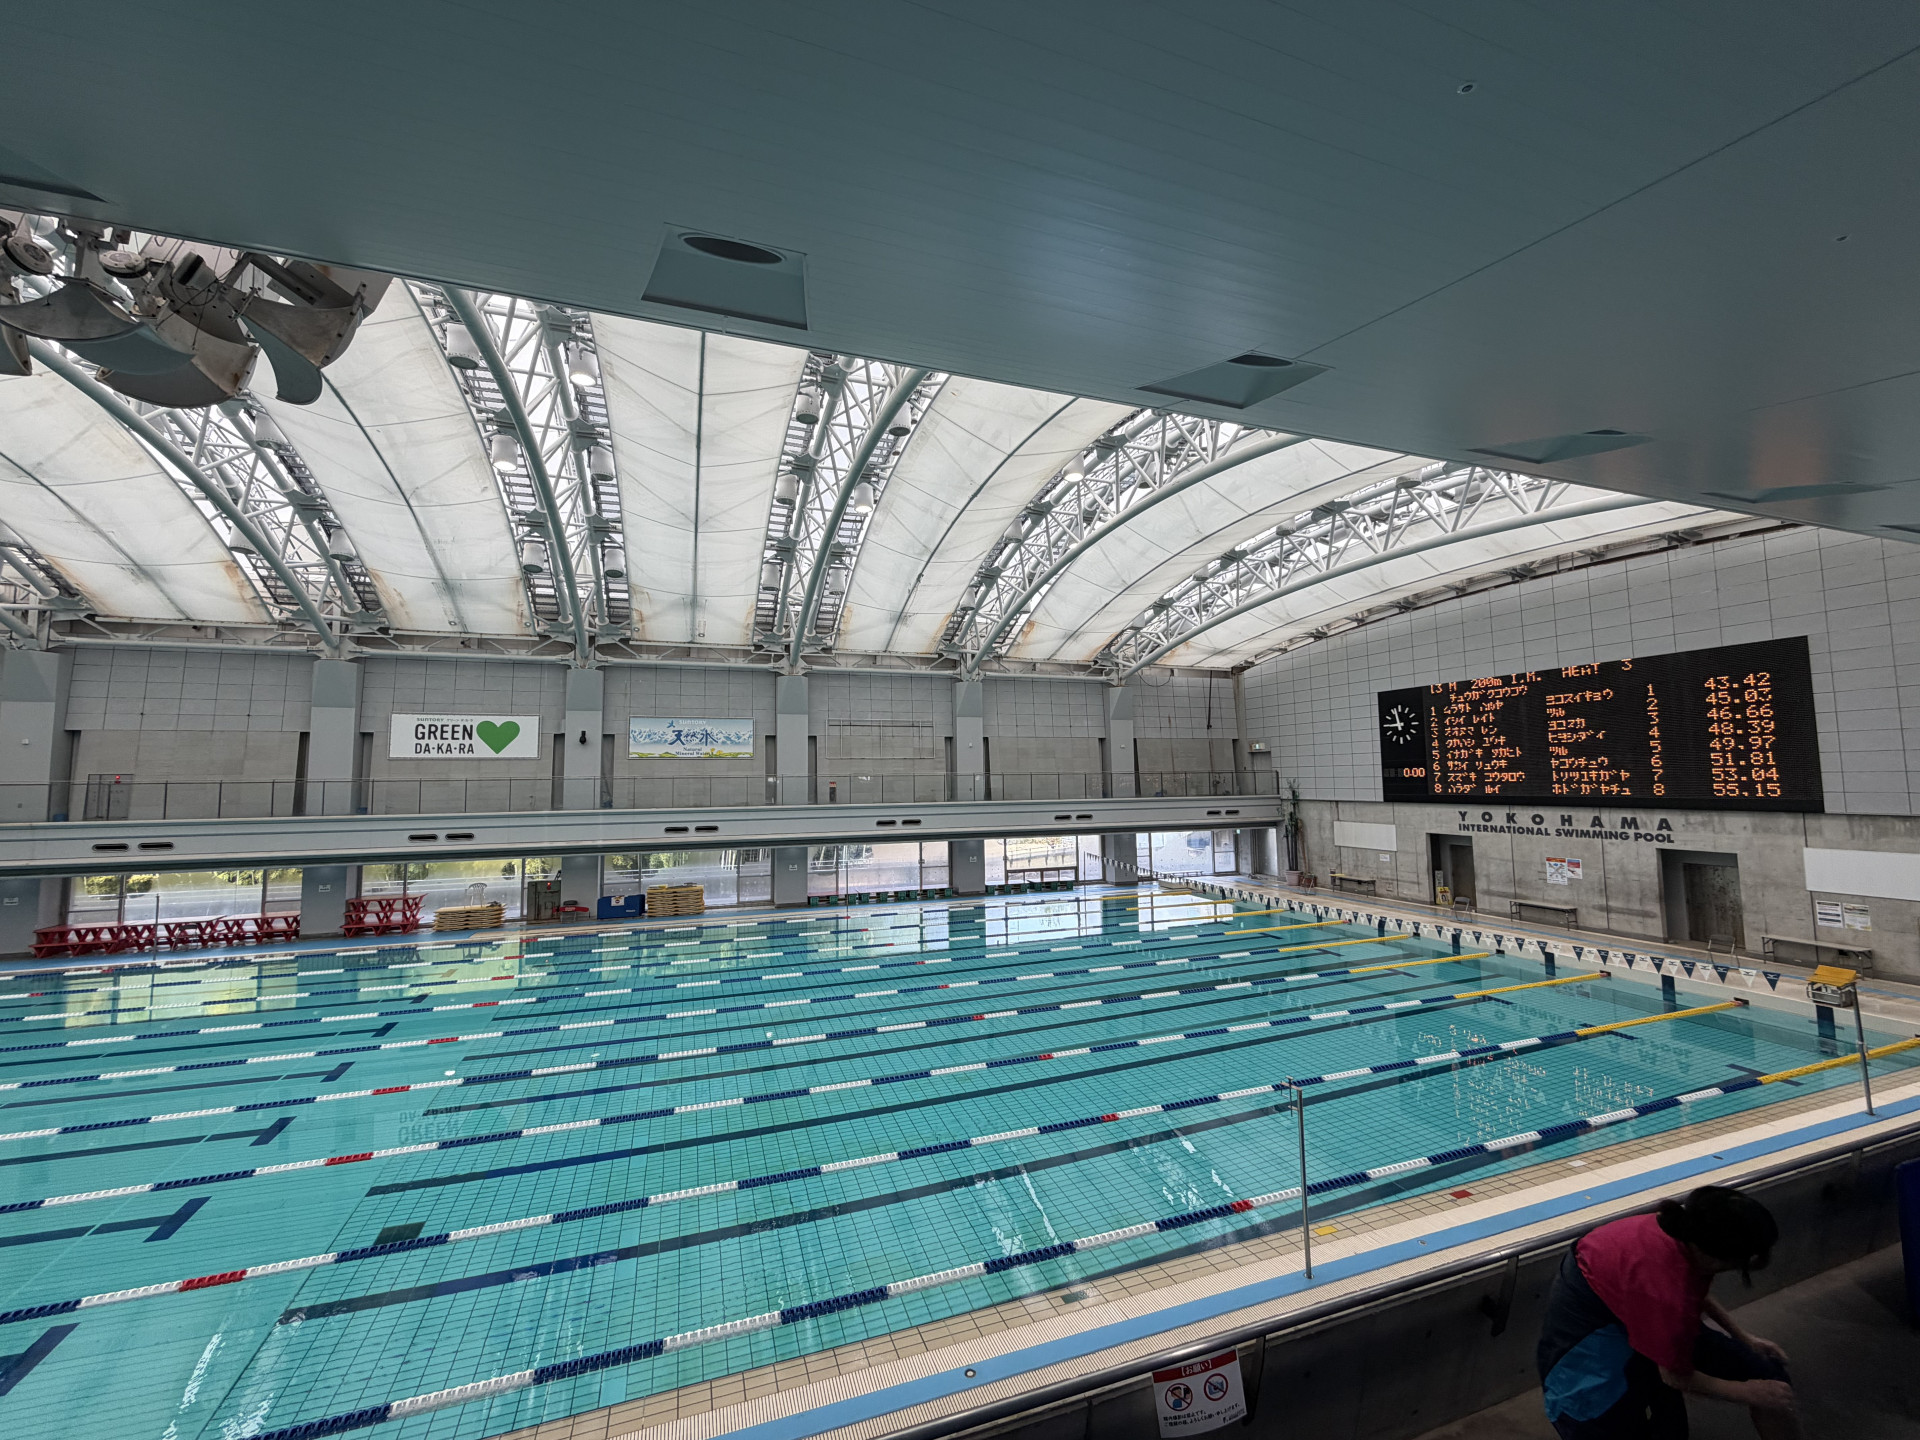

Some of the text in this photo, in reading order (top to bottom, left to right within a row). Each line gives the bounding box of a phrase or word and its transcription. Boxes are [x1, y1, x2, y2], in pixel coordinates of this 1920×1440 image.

[1472, 677, 1502, 689] 200m
[1562, 662, 1600, 678] HEAT
[1621, 658, 1632, 670] 3
[1432, 707, 1436, 715] 1
[1648, 684, 1655, 695] 1
[1704, 672, 1771, 690] 43.42
[1430, 718, 1438, 727] 2
[1647, 698, 1658, 710] 2
[1706, 687, 1772, 705] 45.03
[1432, 728, 1438, 737] 3
[1648, 712, 1659, 724] 3
[1707, 703, 1773, 720] 46.66
[414, 723, 474, 741] GREEN
[668, 729, 718, 746] 天然水
[1432, 739, 1439, 748] 4
[1649, 726, 1660, 738] 4
[1709, 719, 1774, 736] 48.39
[1432, 750, 1440, 759] 5
[1650, 741, 1661, 752] 5
[1710, 735, 1776, 750] 49.97
[1433, 761, 1440, 770] 6
[1651, 755, 1662, 767] 6
[1710, 752, 1776, 765] 51.81
[1434, 772, 1441, 781] 7
[1652, 769, 1663, 781] 7
[1712, 768, 1779, 781] 53.04
[1435, 783, 1442, 793] 8
[1653, 784, 1665, 795] 8
[1713, 783, 1781, 796] 55.15
[1458, 811, 1673, 832] YOKOHAMA
[1459, 823, 1675, 844] INTERNATIONAL SWIMMING POOL
